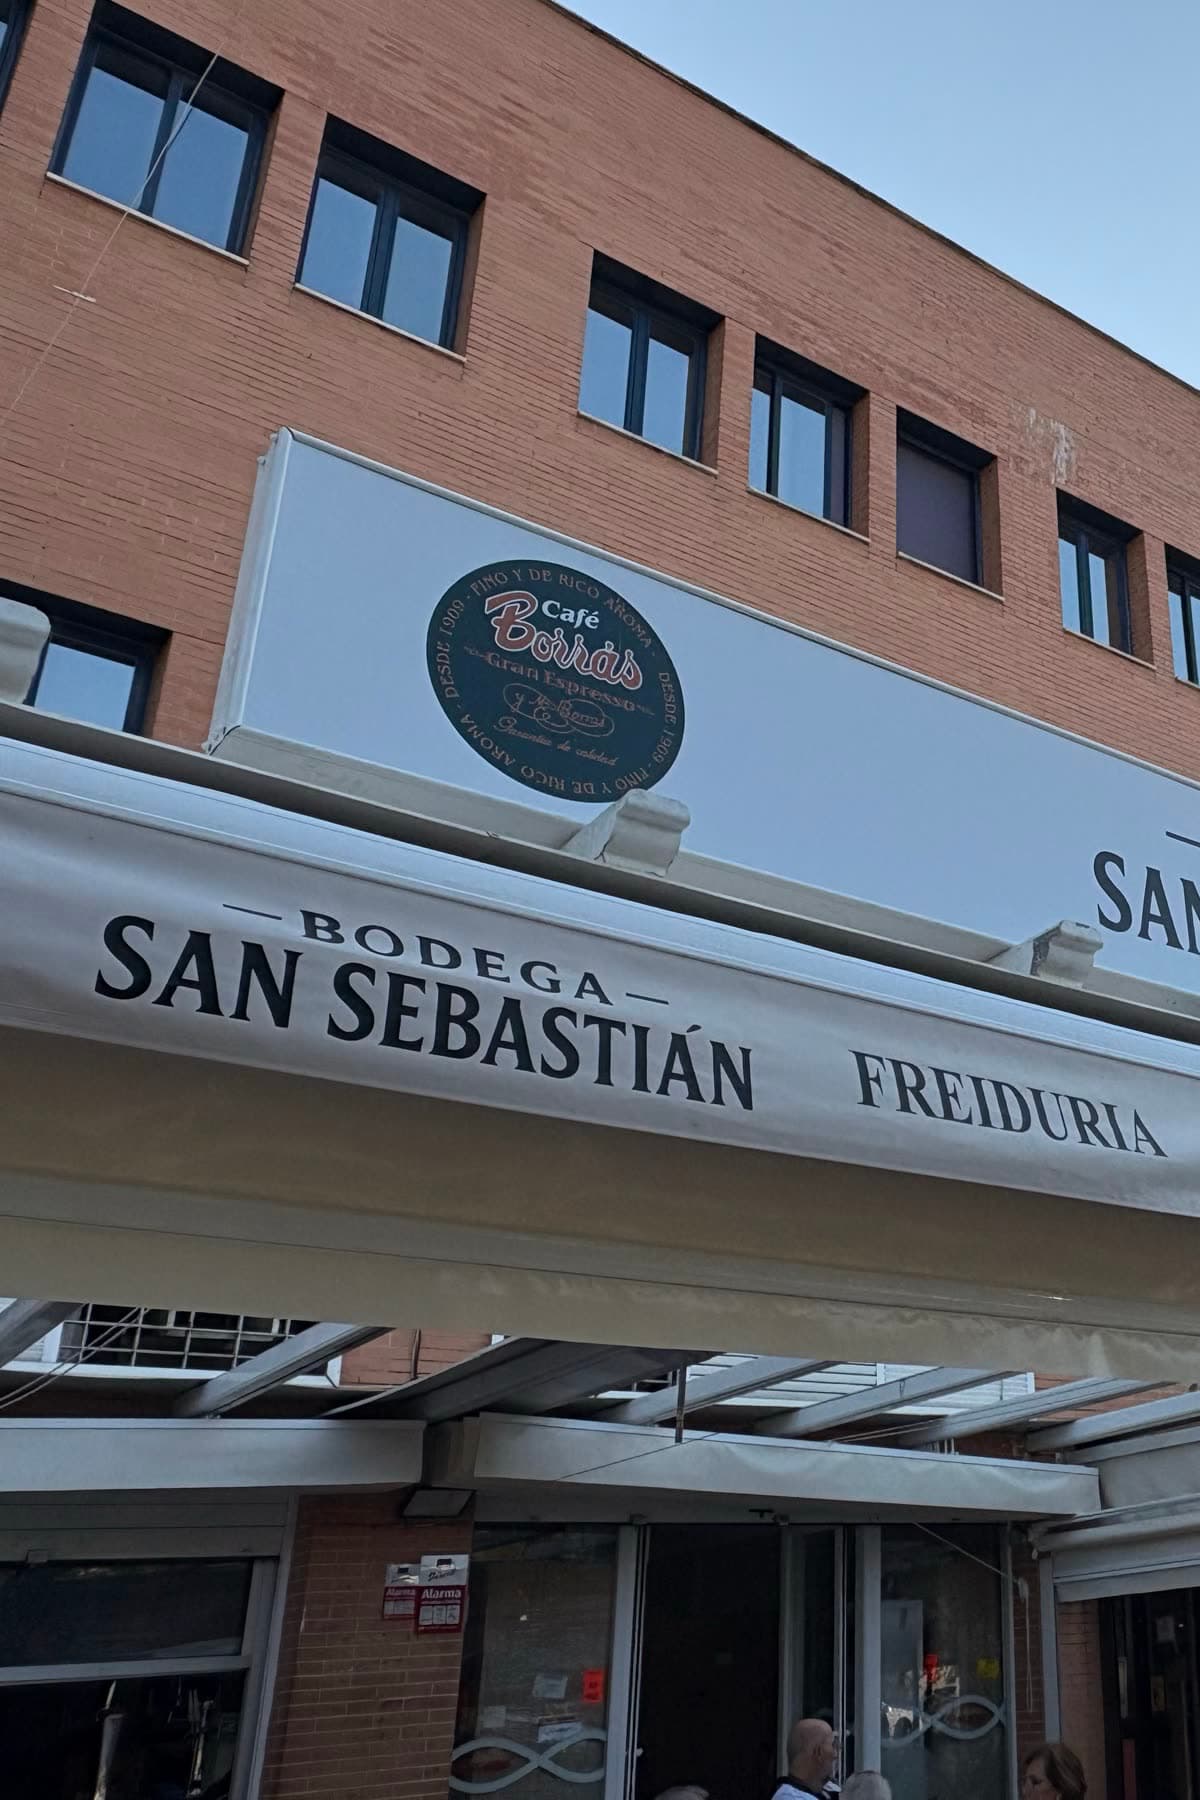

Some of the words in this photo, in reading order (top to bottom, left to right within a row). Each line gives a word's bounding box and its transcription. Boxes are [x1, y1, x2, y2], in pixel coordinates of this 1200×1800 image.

[437, 641, 460, 699] DESDE
[470, 570, 508, 598] FINO
[511, 568, 521, 582] Y
[528, 568, 552, 583] DE
[559, 573, 600, 599] RICO
[604, 597, 652, 648] AROMA
[541, 600, 600, 629] Café
[486, 652, 539, 681] Gran
[544, 668, 637, 713] Espresso
[658, 672, 677, 725] DESDE
[459, 712, 516, 767] AROMA
[520, 764, 566, 791] RICO
[573, 781, 595, 795] DE
[299, 909, 614, 1005] BODEGA
[94, 914, 304, 1029] SAN
[326, 961, 754, 1111] SEBASTIÁN
[847, 1049, 1169, 1159] FREIDURIA
[421, 1588, 462, 1599] Alarma
